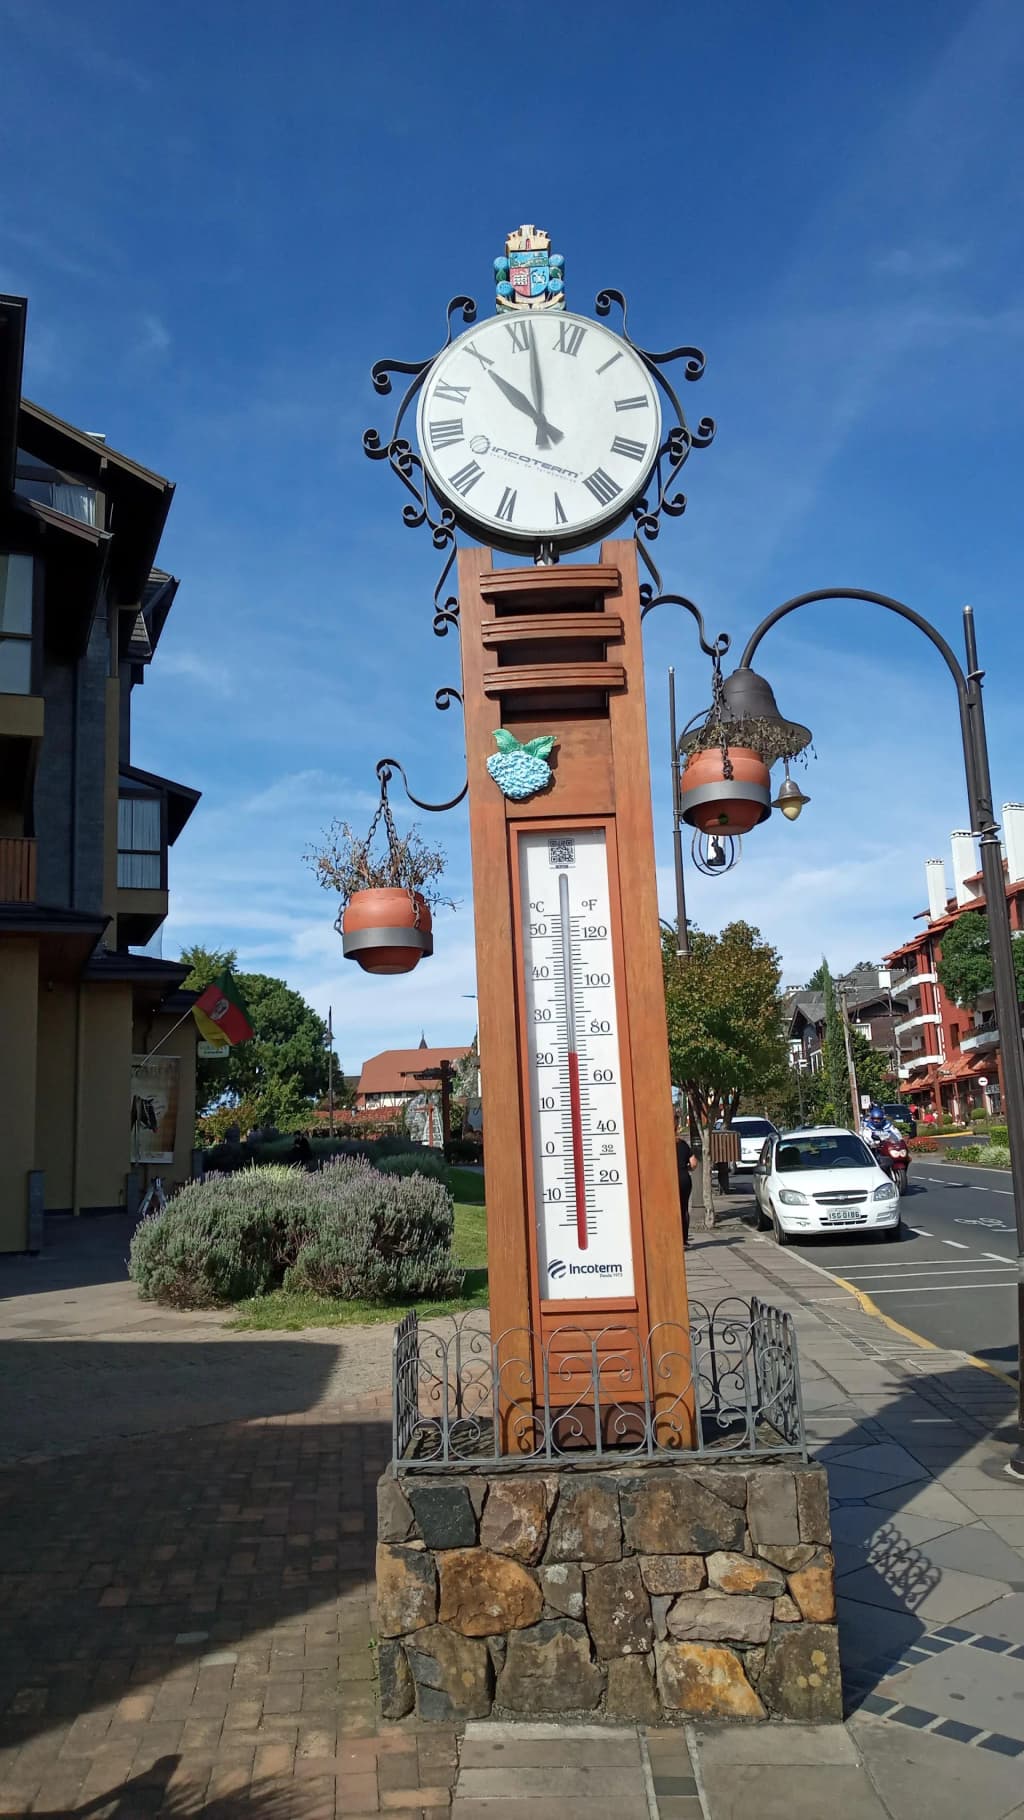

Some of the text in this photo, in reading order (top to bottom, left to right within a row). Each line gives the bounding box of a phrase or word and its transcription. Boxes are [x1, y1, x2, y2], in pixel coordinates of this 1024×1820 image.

[552, 320, 588, 357] XII
[462, 340, 495, 370] X
[432, 378, 471, 405] IX
[614, 395, 649, 412] II
[429, 418, 465, 452] VIII
[610, 434, 648, 463] III
[448, 459, 485, 497] VII
[582, 466, 623, 506] IIII
[494, 486, 517, 522] VI
[554, 490, 568, 525] V
[529, 924, 547, 936] 50
[582, 925, 608, 938] 120
[532, 966, 549, 978] 40
[584, 973, 611, 986] 100
[534, 1009, 551, 1021] 30
[590, 1018, 610, 1033] 80
[536, 1052, 554, 1065] 20
[593, 1069, 614, 1082] 60
[541, 1097, 555, 1109] 10
[596, 1119, 617, 1132] 40
[545, 1141, 555, 1154] 0
[601, 1144, 614, 1153] 32
[599, 1169, 620, 1182] 20
[542, 1187, 562, 1201] -10
[569, 1264, 623, 1275] Incoterm
